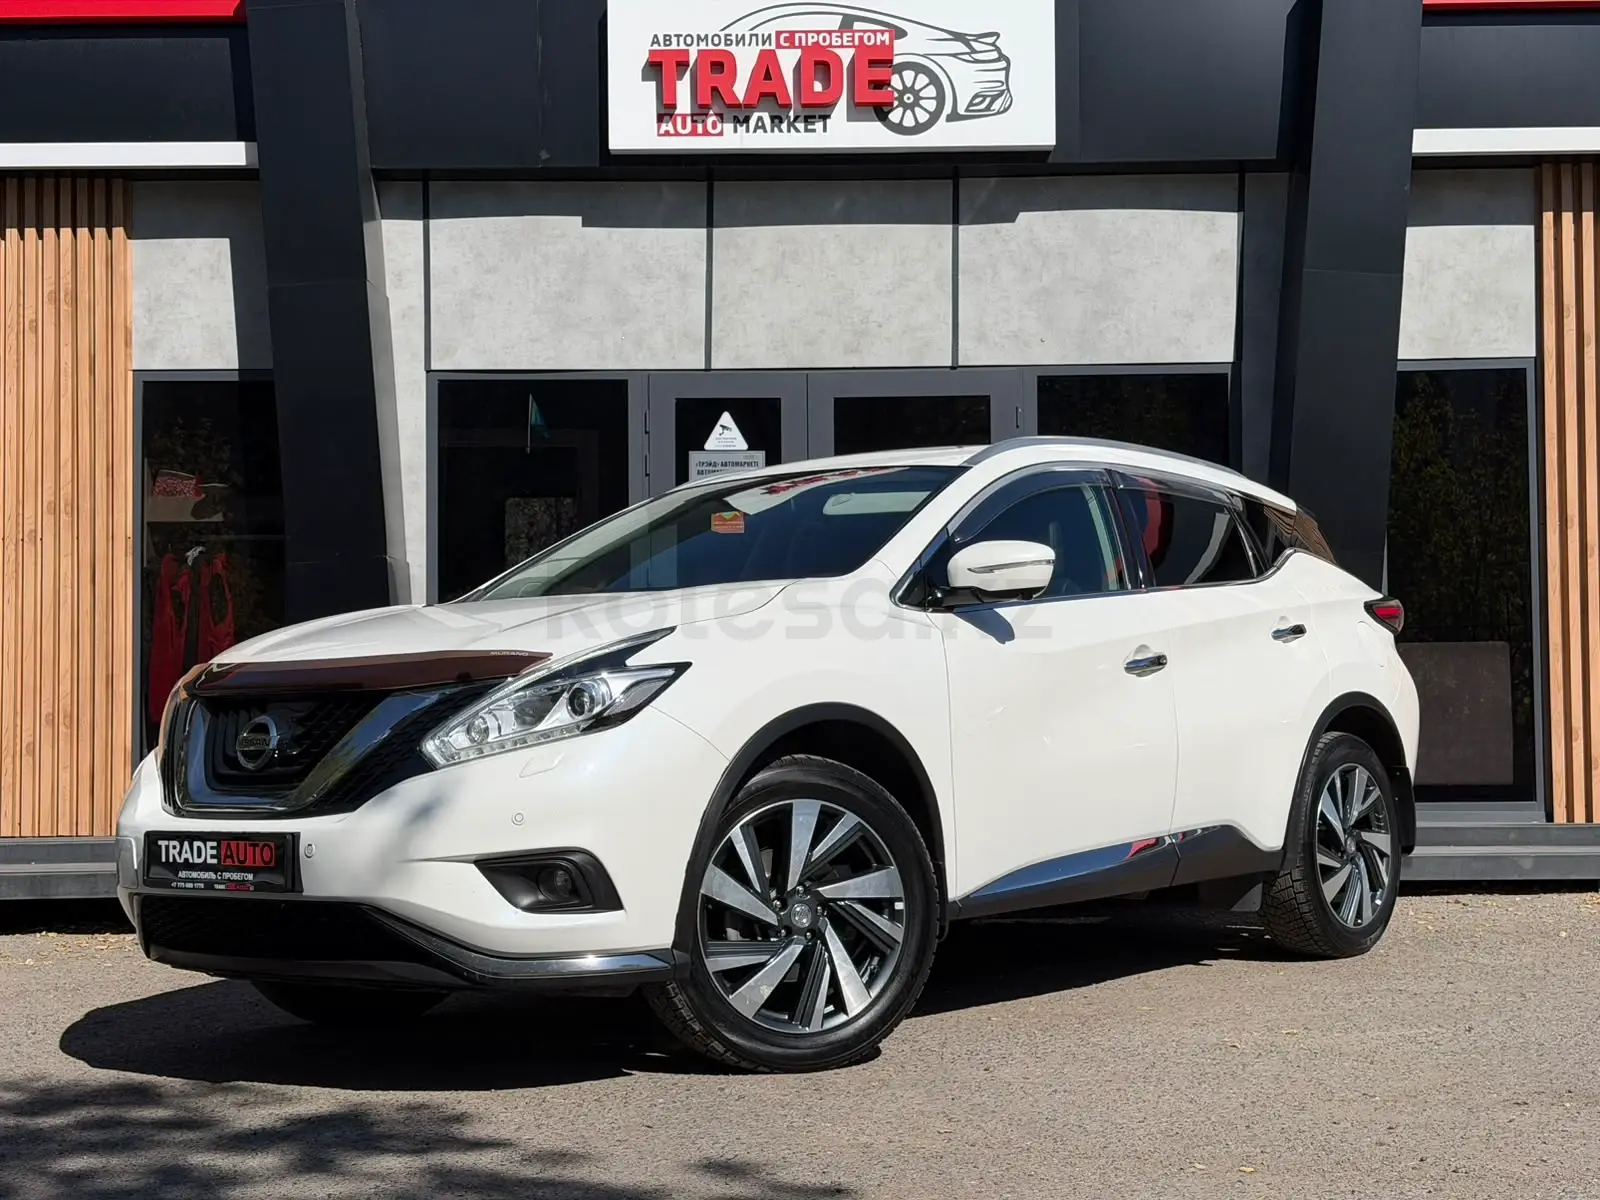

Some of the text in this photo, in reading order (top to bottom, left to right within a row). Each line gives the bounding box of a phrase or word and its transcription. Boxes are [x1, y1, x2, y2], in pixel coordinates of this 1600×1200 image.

[650, 31, 890, 48] АВТОМОБИЛИ С ПРОБЕГОМ
[648, 49, 894, 108] TRADE
[659, 115, 830, 136] AUTO MARKET
[158, 840, 274, 864] TRADE AUTO
[178, 870, 216, 879] АВТОМОБИЛЬ
[222, 872, 254, 880] ПРОБЕГОМ
